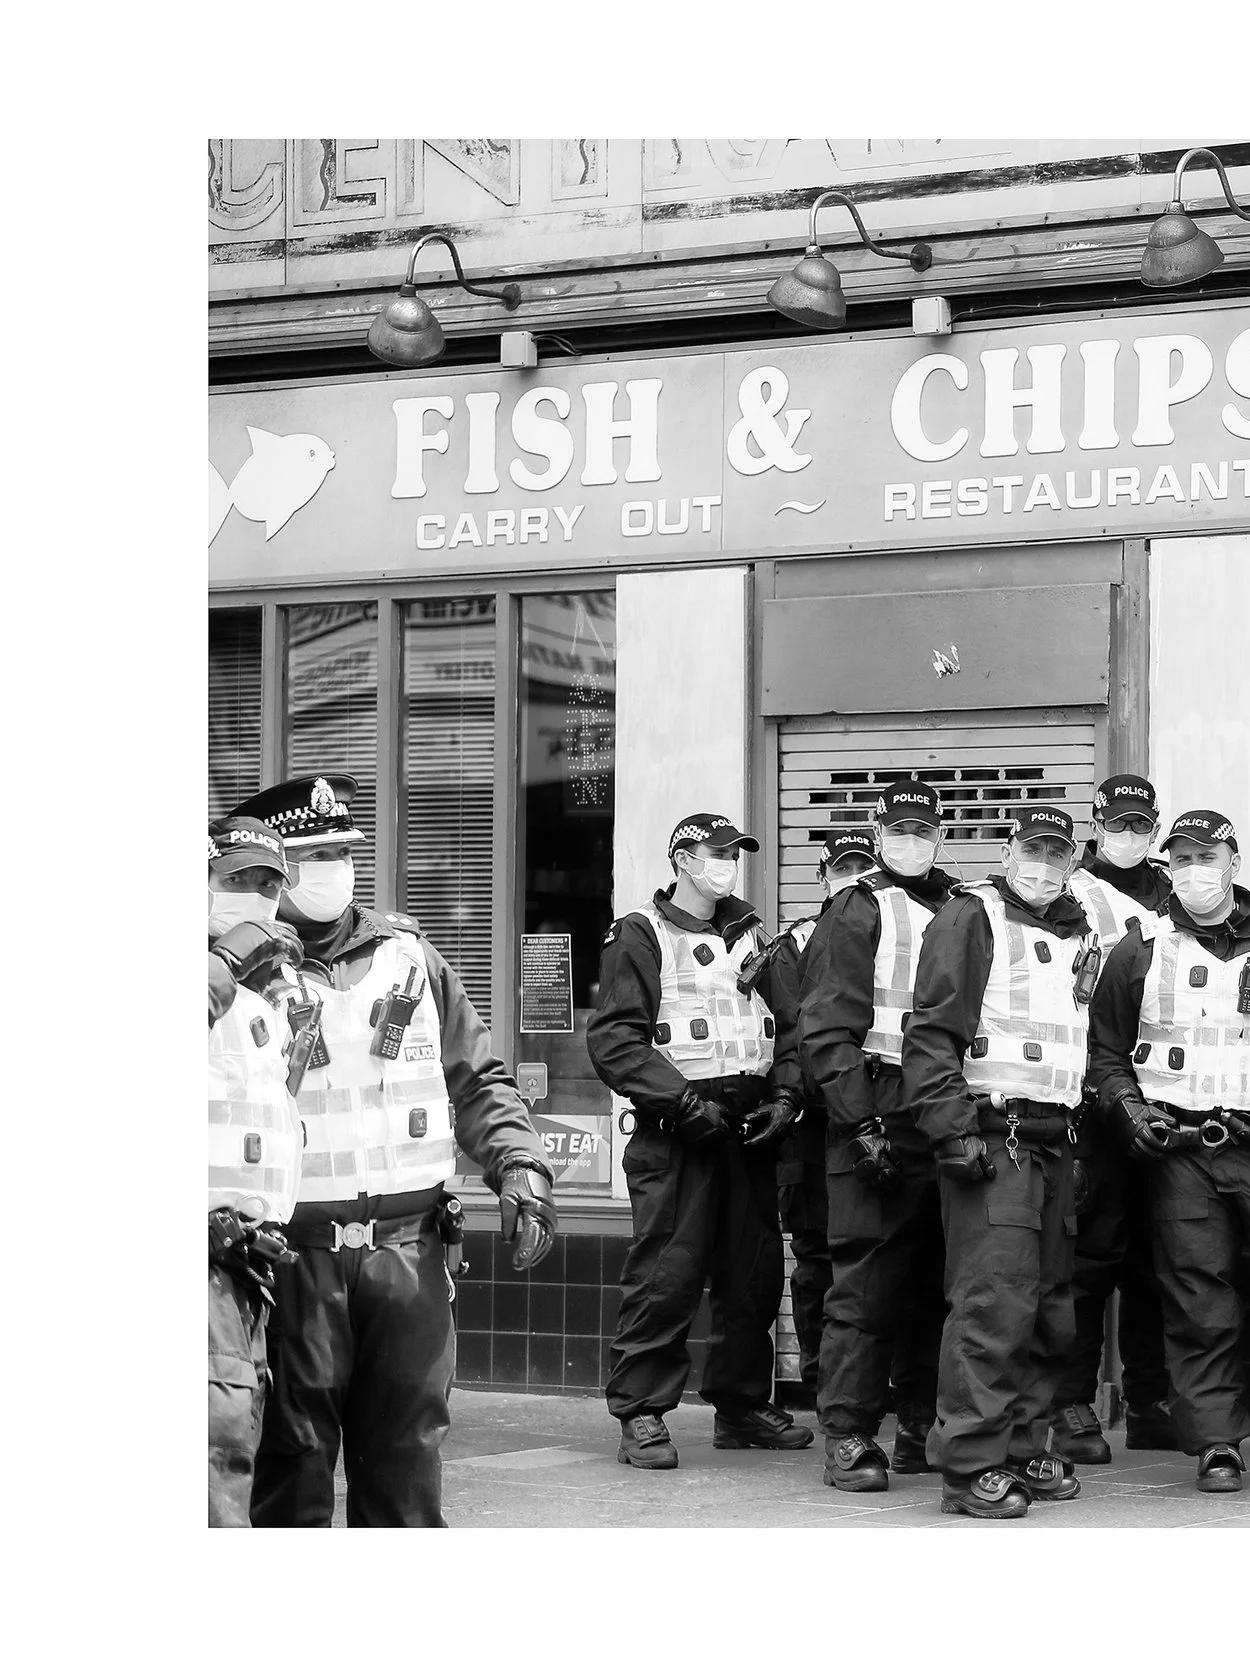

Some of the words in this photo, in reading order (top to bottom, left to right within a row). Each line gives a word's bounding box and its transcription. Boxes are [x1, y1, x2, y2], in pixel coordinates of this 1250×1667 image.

[391, 377, 663, 499] FISH
[726, 365, 813, 476] &
[416, 504, 585, 550] CARRY
[621, 495, 722, 537] OUT
[892, 793, 931, 805] POLICE
[1114, 786, 1149, 800] POLICE
[1031, 813, 1068, 829] POLICE
[1174, 818, 1210, 830] POLICE
[230, 830, 280, 853] POLICE
[835, 836, 870, 846] POLICE
[406, 1046, 433, 1061] POLICE
[541, 1132, 567, 1153] ST
[569, 1133, 603, 1153] EAT
[579, 1159, 591, 1168] app
